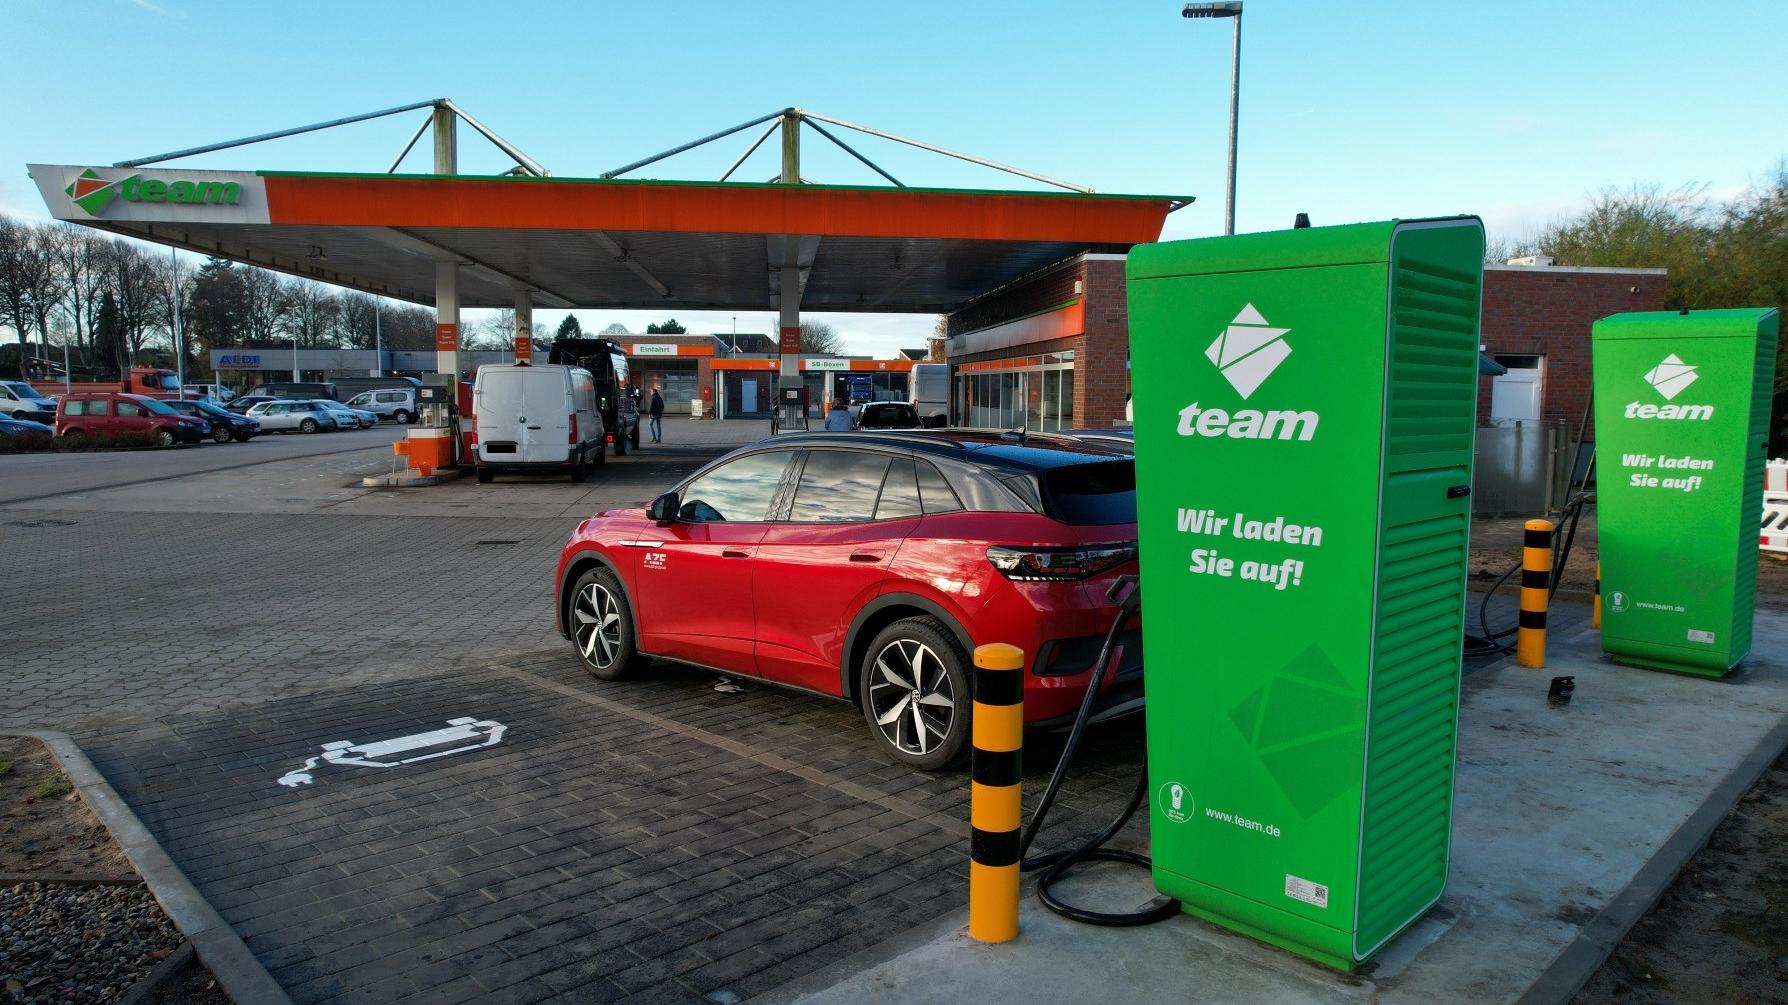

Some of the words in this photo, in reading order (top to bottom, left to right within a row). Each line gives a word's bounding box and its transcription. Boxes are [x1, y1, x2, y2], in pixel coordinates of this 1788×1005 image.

[121, 173, 241, 205] team
[1177, 401, 1320, 441] team
[1624, 400, 1714, 420] team
[1622, 454, 1656, 467] Wir
[1657, 455, 1714, 470] laden
[1629, 473, 1659, 487] Sie
[1661, 475, 1702, 492] auf!
[1176, 508, 1229, 536] Wir
[1232, 512, 1323, 546] laden
[1189, 548, 1235, 577] Sie
[1240, 558, 1304, 591] auf!
[1636, 601, 1685, 612] www.team.de
[1205, 807, 1281, 837] www.team.de
